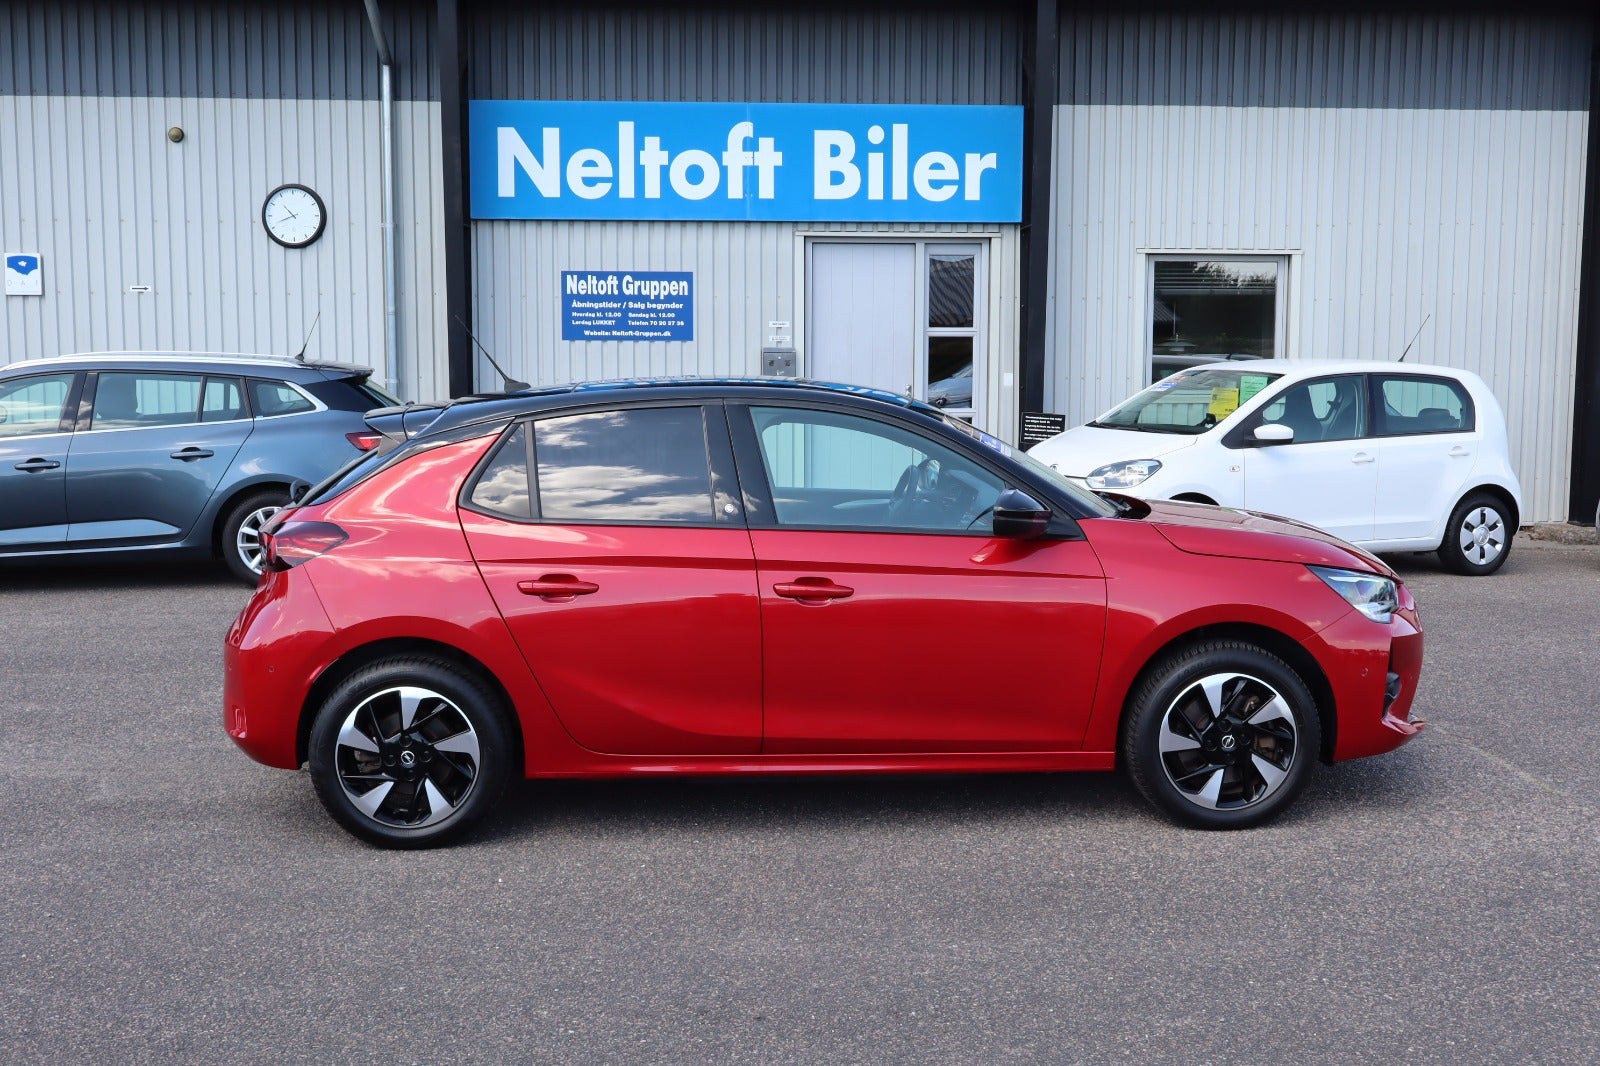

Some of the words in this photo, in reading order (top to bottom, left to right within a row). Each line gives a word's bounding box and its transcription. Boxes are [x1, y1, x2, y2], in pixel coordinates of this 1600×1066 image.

[497, 120, 783, 200] Neltoft
[814, 123, 998, 202] Biler
[567, 275, 618, 295] Neltoft
[622, 275, 688, 299] Gruppen
[572, 299, 621, 309] Åbningstider
